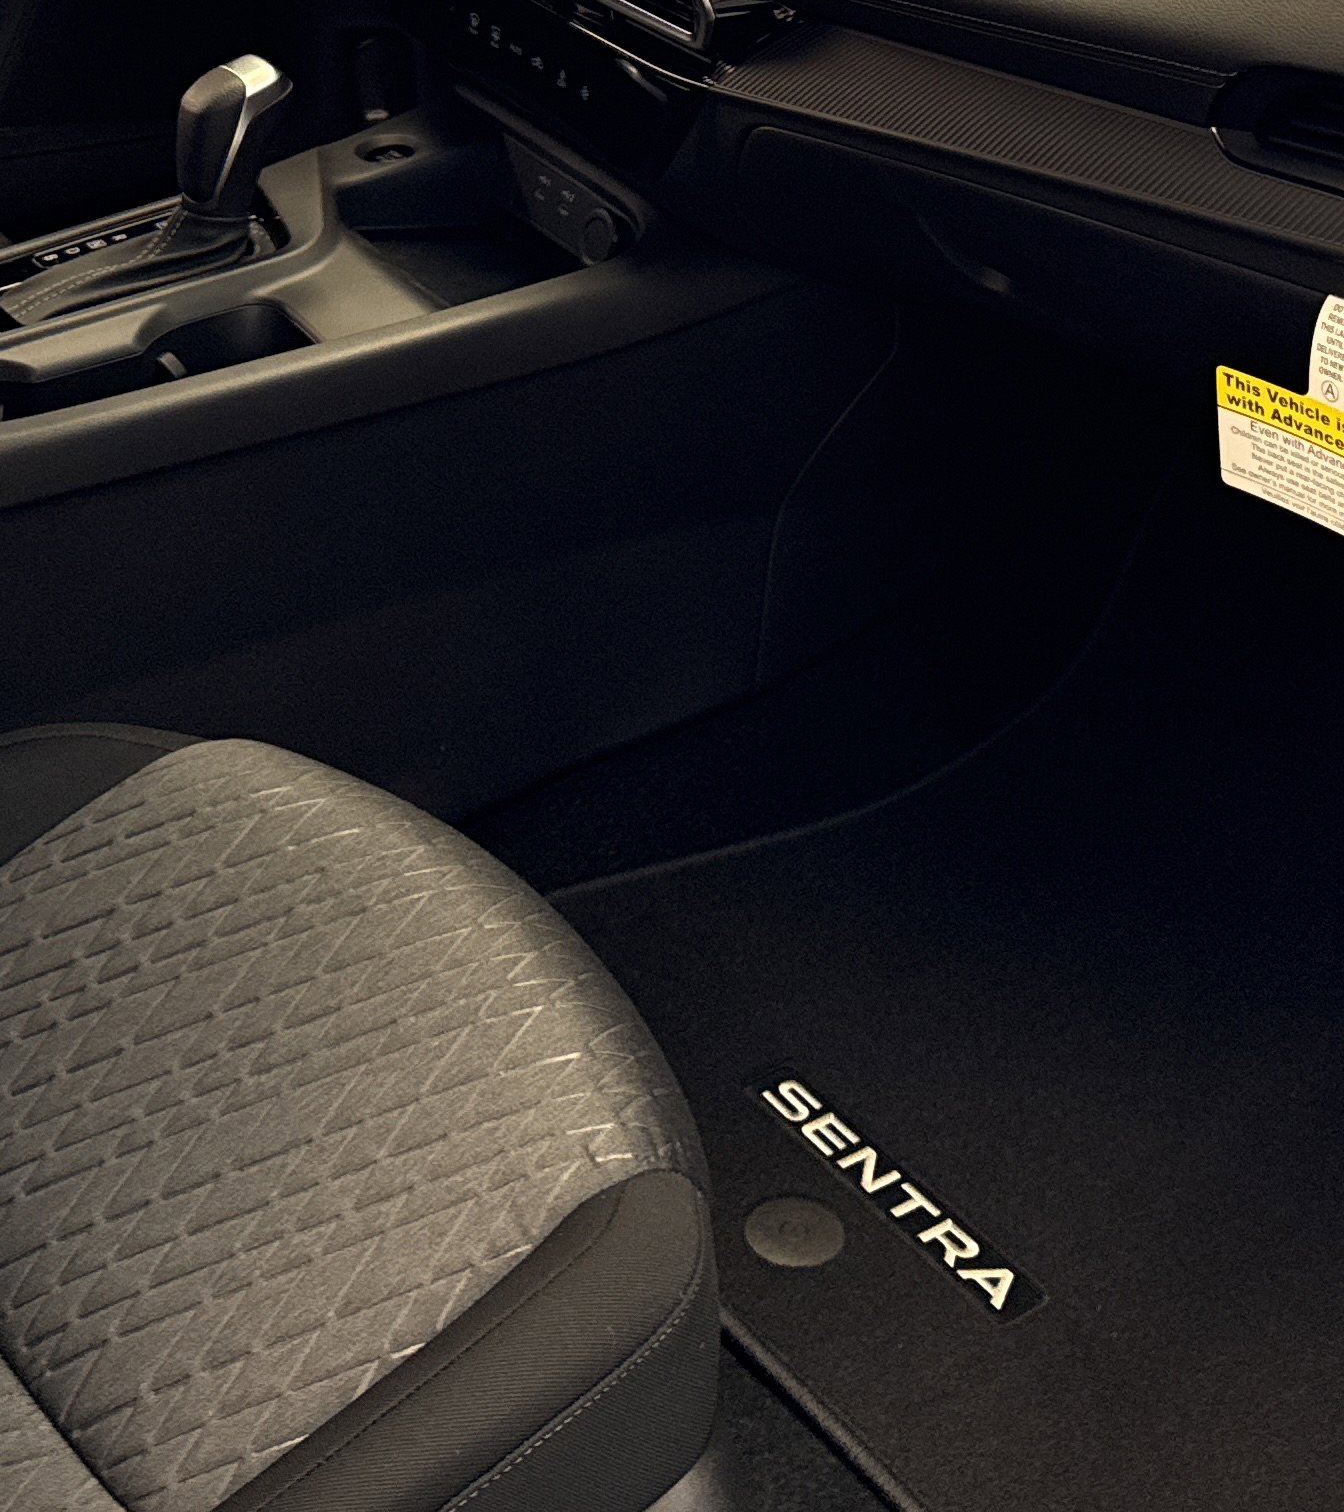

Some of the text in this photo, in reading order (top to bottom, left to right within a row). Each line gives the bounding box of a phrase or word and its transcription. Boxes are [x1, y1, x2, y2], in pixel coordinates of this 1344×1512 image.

[1222, 372, 1260, 396] This
[1267, 388, 1330, 426] Vehicle
[1226, 391, 1264, 415] with
[1250, 420, 1278, 441] Even
[1282, 433, 1304, 451] with
[761, 1079, 1015, 1311] SENTRA
